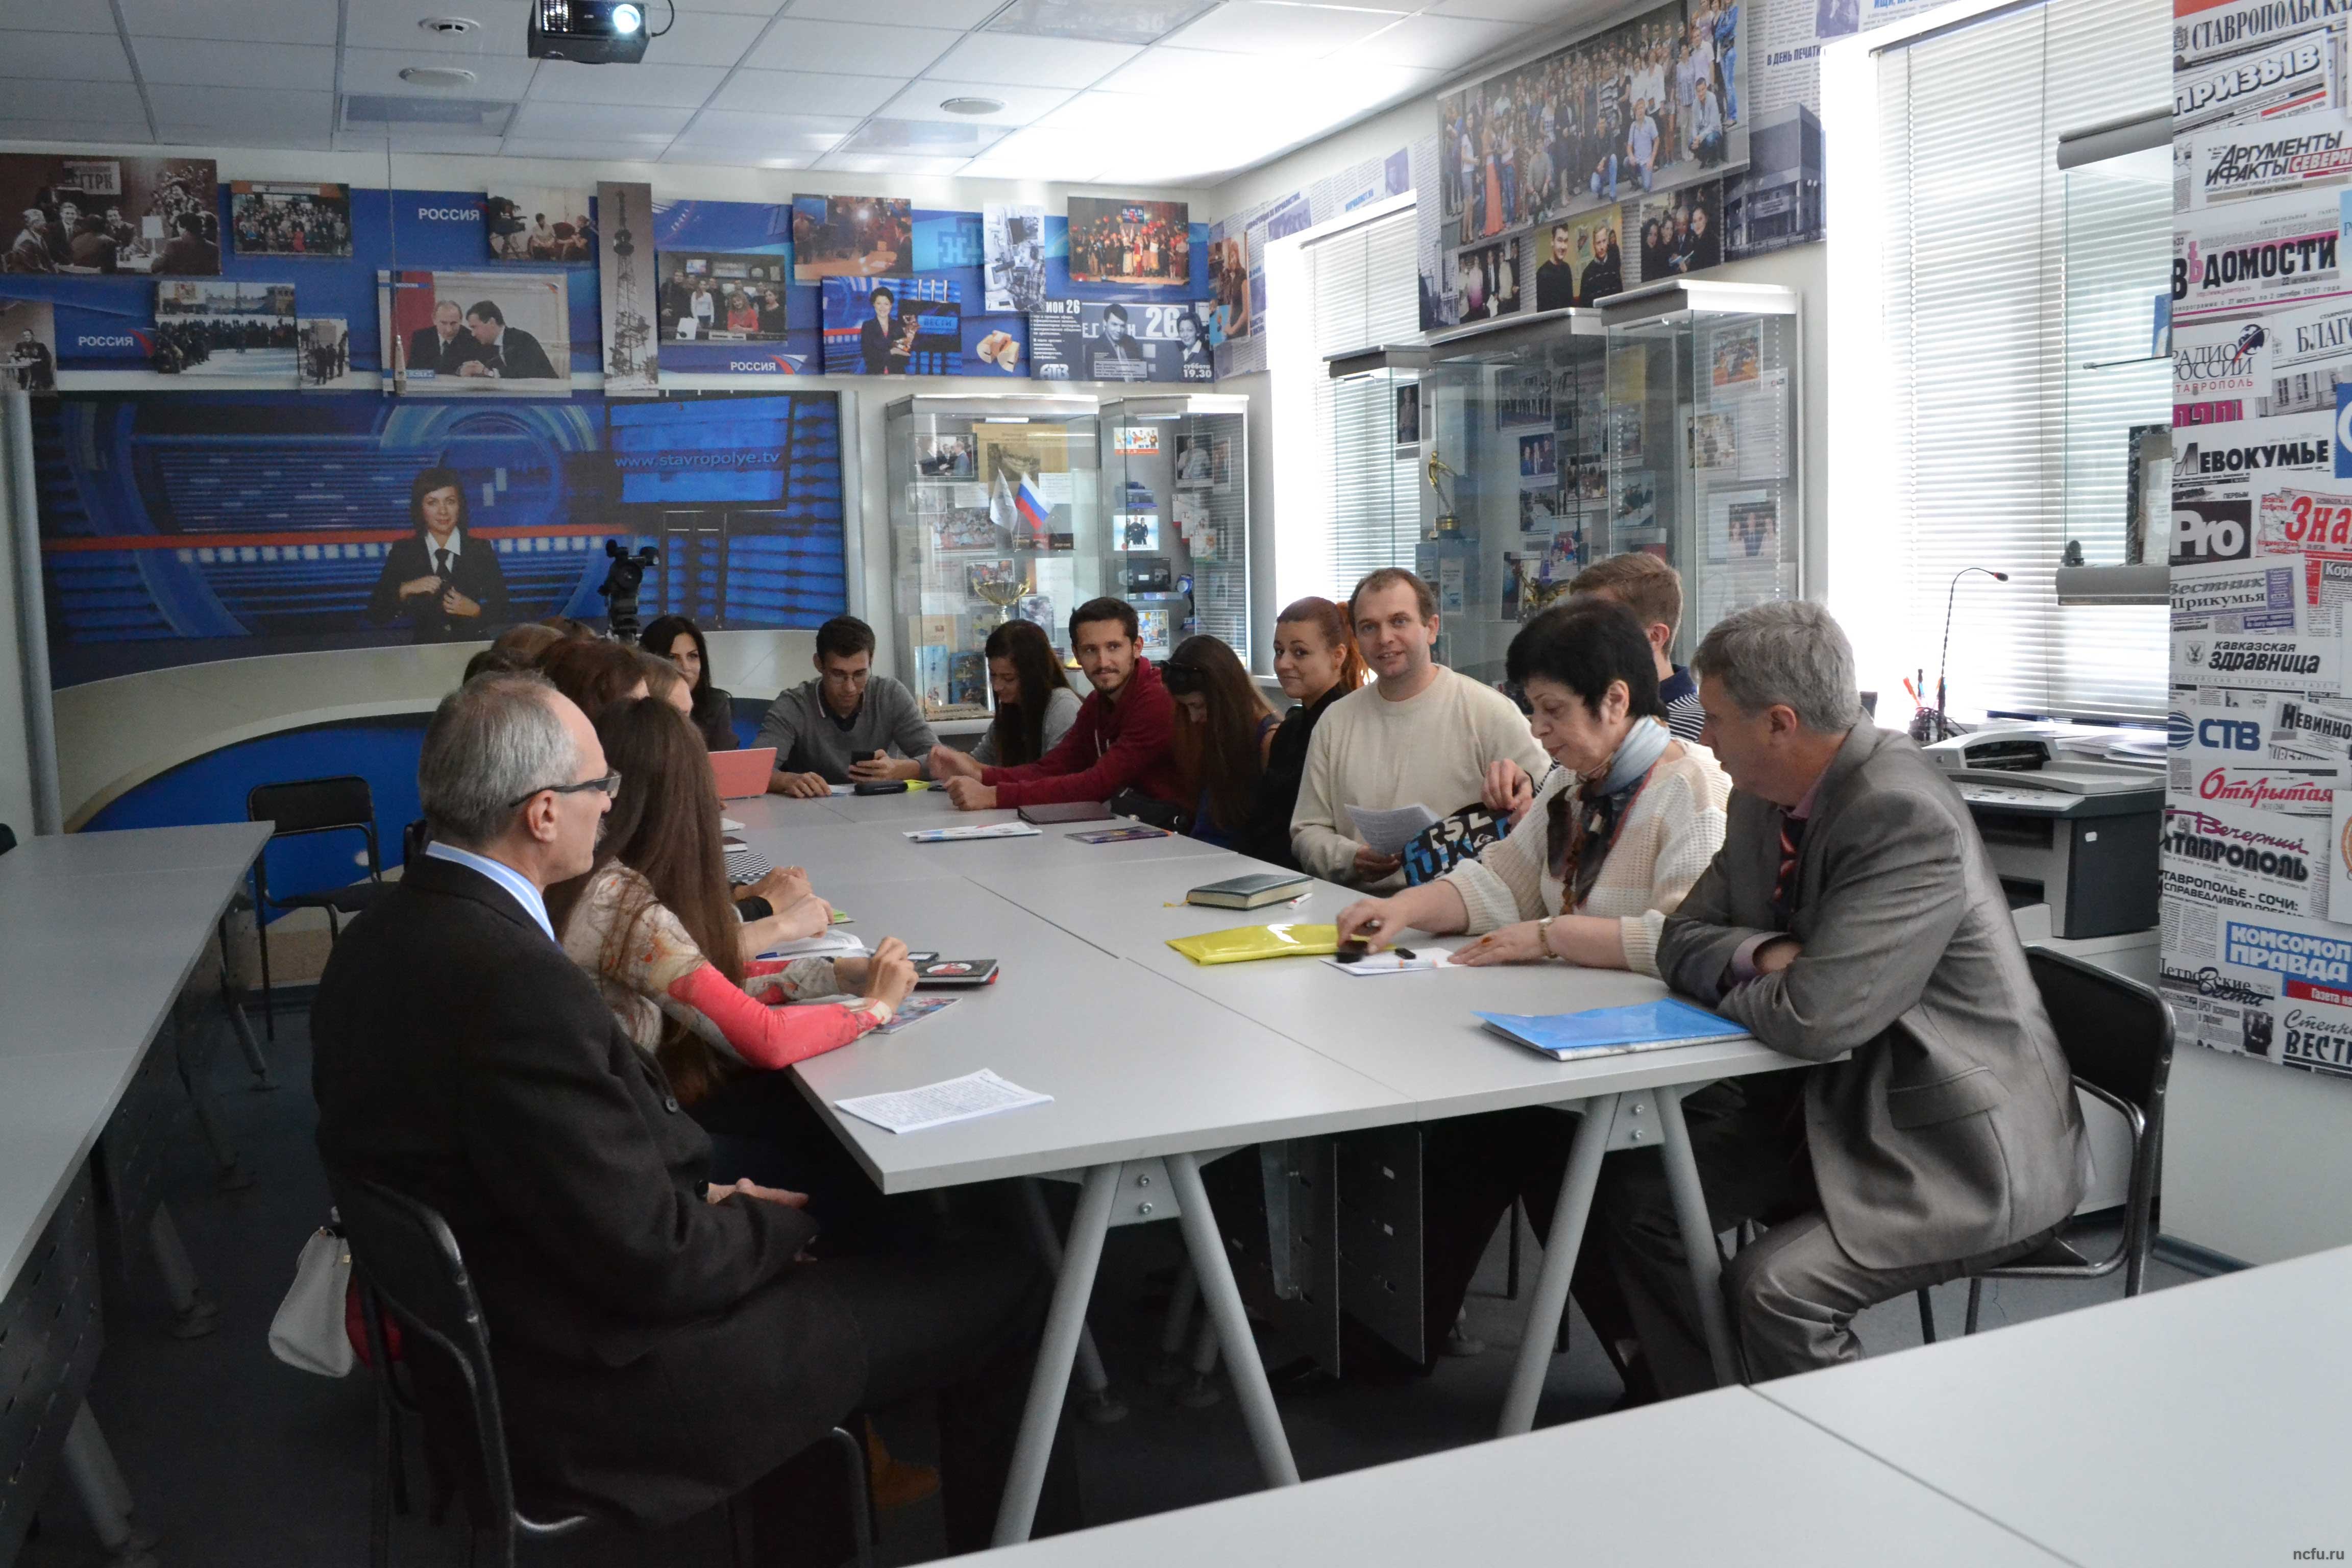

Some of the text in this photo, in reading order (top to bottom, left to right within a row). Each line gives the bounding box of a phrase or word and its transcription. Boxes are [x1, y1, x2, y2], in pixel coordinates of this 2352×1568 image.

[2192, 0, 2352, 51] СТАВРОПОЛЬСК
[1767, 54, 1772, 65] В
[1773, 51, 1793, 66] ДЕНЬ
[2173, 44, 2320, 116] ПРИЗЫВ
[2220, 131, 2343, 165] АРГУМЕНТЫ
[418, 207, 480, 220] РОССИЯ
[1066, 300, 1080, 314] 26
[1145, 307, 1181, 338] 26
[78, 336, 134, 347] РОССИЯ
[2172, 344, 2239, 366] РАДИО
[730, 361, 776, 372] РОССИЯ
[1184, 369, 1212, 378] 19.30
[2172, 357, 2253, 381] РОССИИ
[2175, 378, 2253, 393] ТАВРОПОЛЬ
[615, 451, 780, 467] www.stavropolye.tv
[2173, 439, 2329, 477] ЛЕВОКУМЬЕ
[2170, 510, 2244, 556] Pro
[2285, 496, 2352, 544] Зна
[2171, 592, 2265, 611] Прикумья
[2169, 675, 2231, 683] РОССИЙСКАЯ
[2238, 678, 2295, 687] КУРОРТНАЯ
[2198, 718, 2260, 751] СТВ
[2199, 767, 2333, 808] Открытая
[2165, 809, 2310, 855] Вечерний
[2163, 870, 2247, 898] ТАВРОПОЛЬЕ
[2164, 883, 2252, 909] СПРАВЕДЛИВУЮ
[2231, 925, 2351, 962] КОМСОМОЛ
[2229, 944, 2348, 983] ПРАВДА
